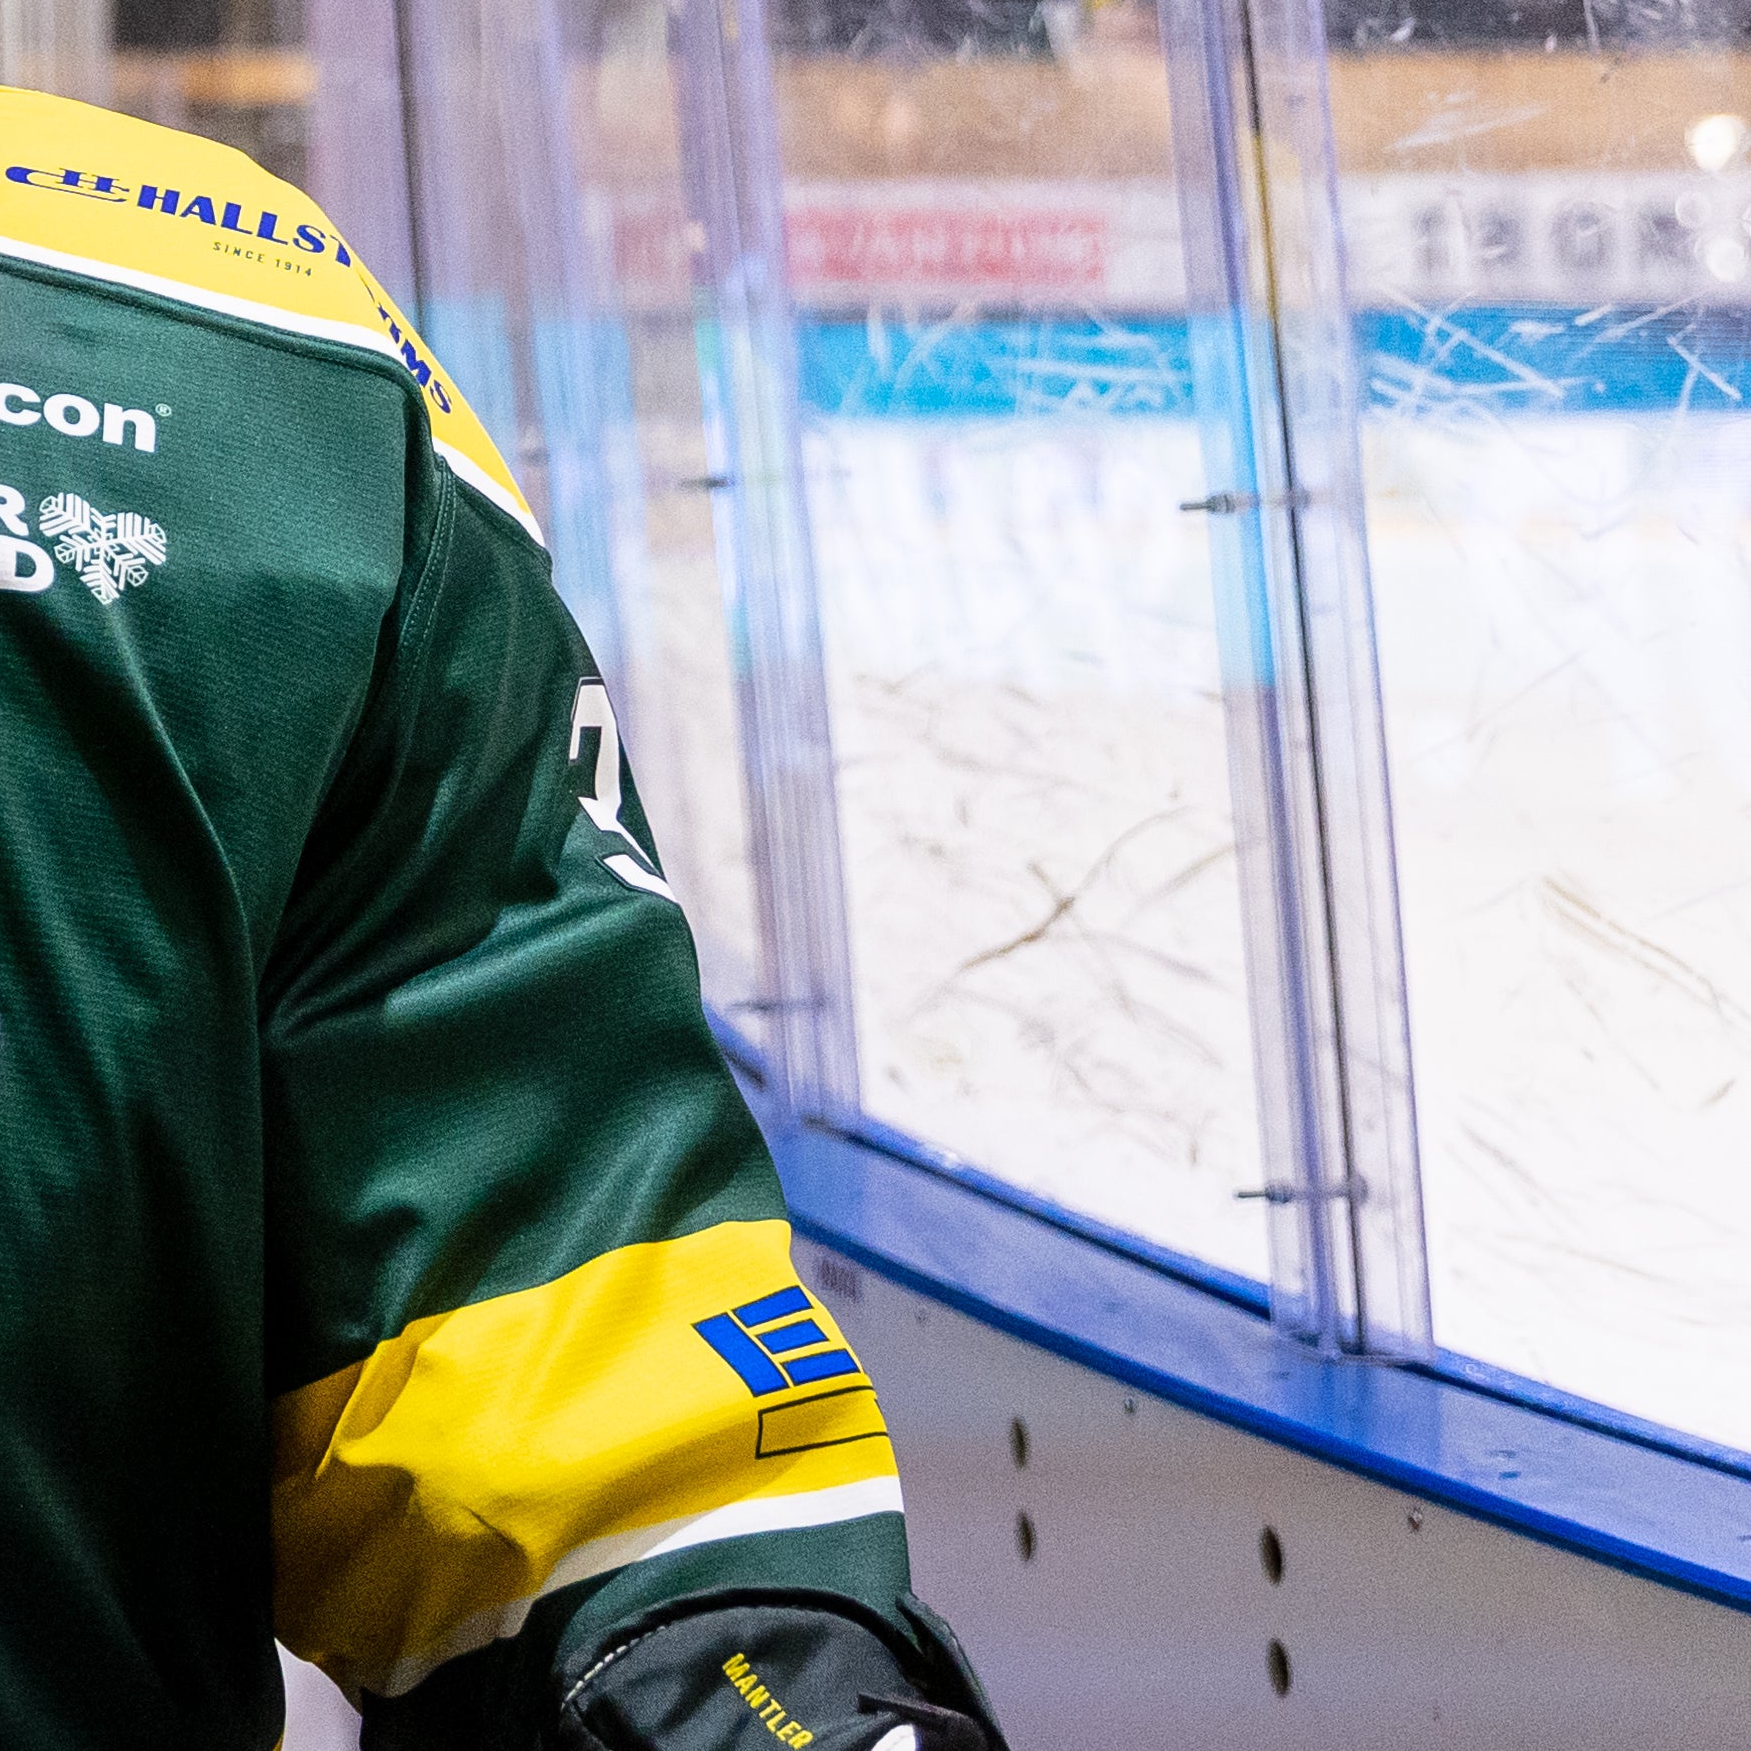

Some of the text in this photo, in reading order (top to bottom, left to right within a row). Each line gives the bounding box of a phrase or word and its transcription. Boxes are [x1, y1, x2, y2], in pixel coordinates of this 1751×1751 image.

[138, 184, 453, 414] HALLSTMS
[212, 241, 313, 277] SINCE 1914
[721, 1651, 816, 1751] MANTLER
